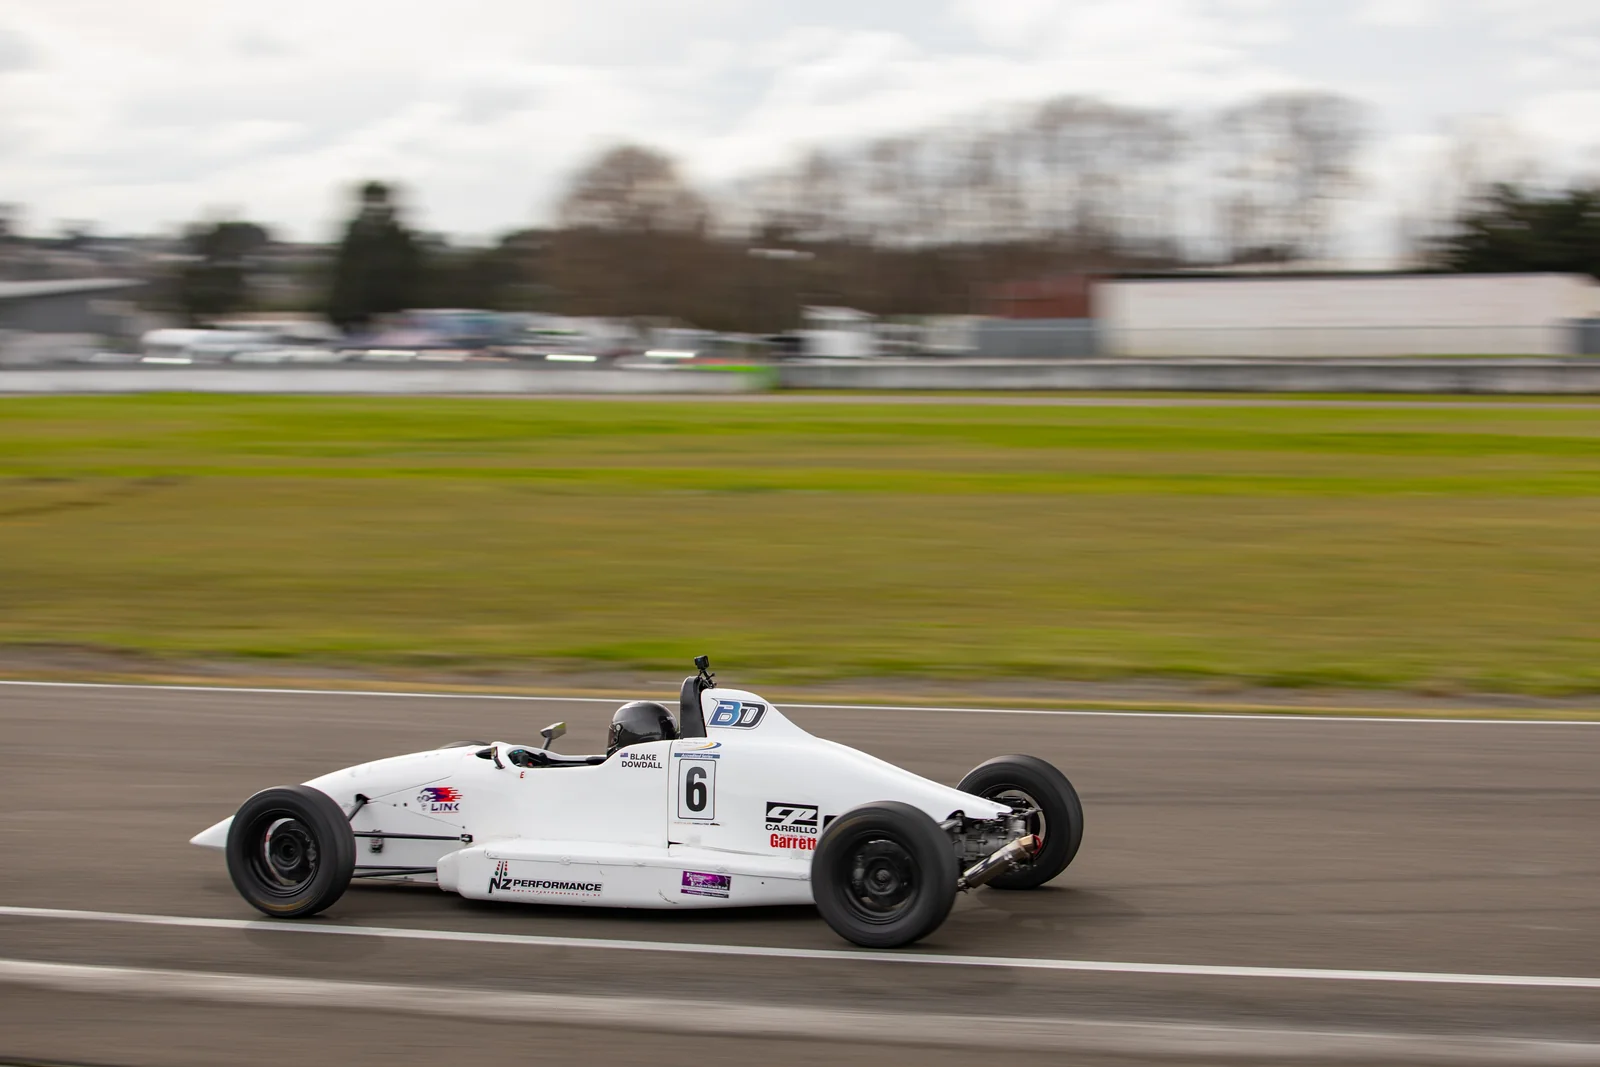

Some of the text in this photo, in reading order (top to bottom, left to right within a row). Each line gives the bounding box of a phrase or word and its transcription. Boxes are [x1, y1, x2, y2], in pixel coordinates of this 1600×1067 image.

[706, 699, 767, 729] BD
[630, 753, 657, 761] BLAKE
[621, 761, 663, 769] DOWDALL
[686, 767, 707, 812] 6
[431, 803, 460, 811] LINK
[765, 824, 818, 834] CARRILLO
[770, 833, 817, 851] Garrett
[513, 879, 602, 892] PERFORMANCE
